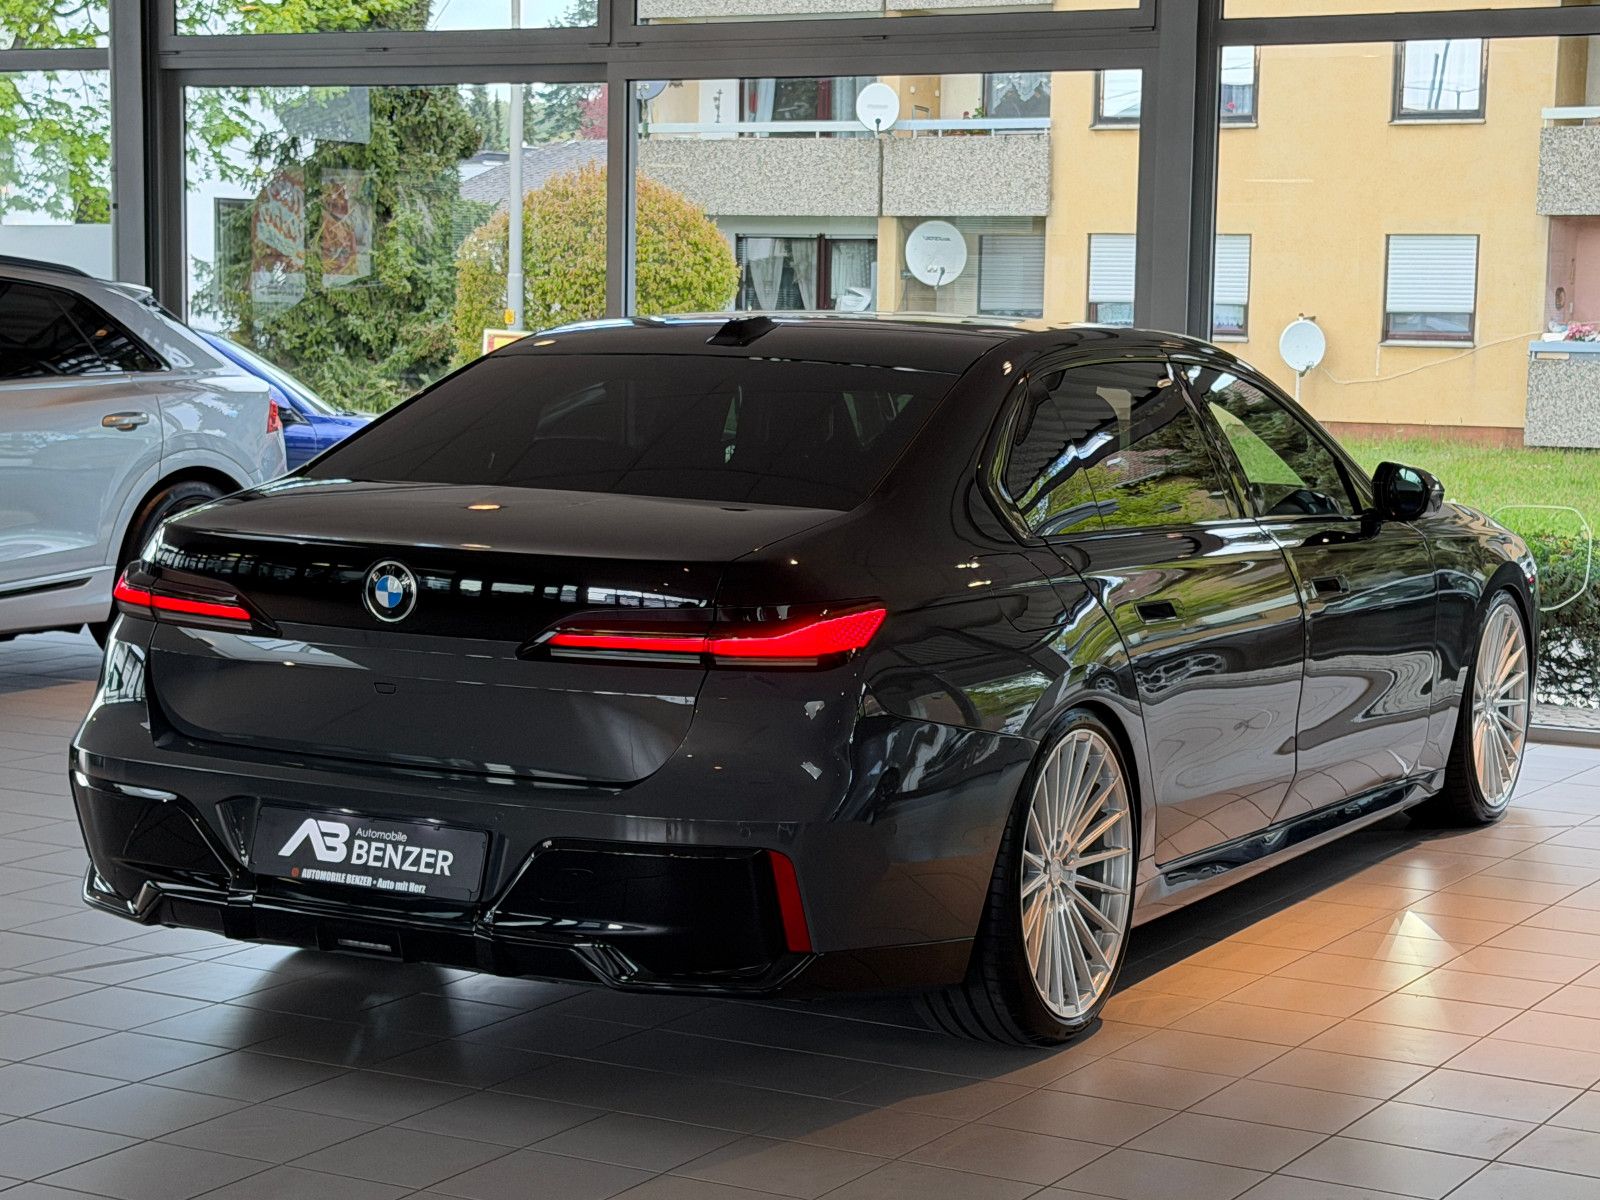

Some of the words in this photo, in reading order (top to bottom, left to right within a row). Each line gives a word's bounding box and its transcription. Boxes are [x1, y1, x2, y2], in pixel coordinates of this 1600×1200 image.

[355, 827, 408, 842] Automobile
[350, 840, 454, 877] BENZER
[302, 868, 346, 883] AUTOMOBILE
[346, 873, 373, 887] BENZER
[377, 878, 395, 890] Auto
[395, 881, 409, 892] mit
[409, 882, 426, 894] Herz
